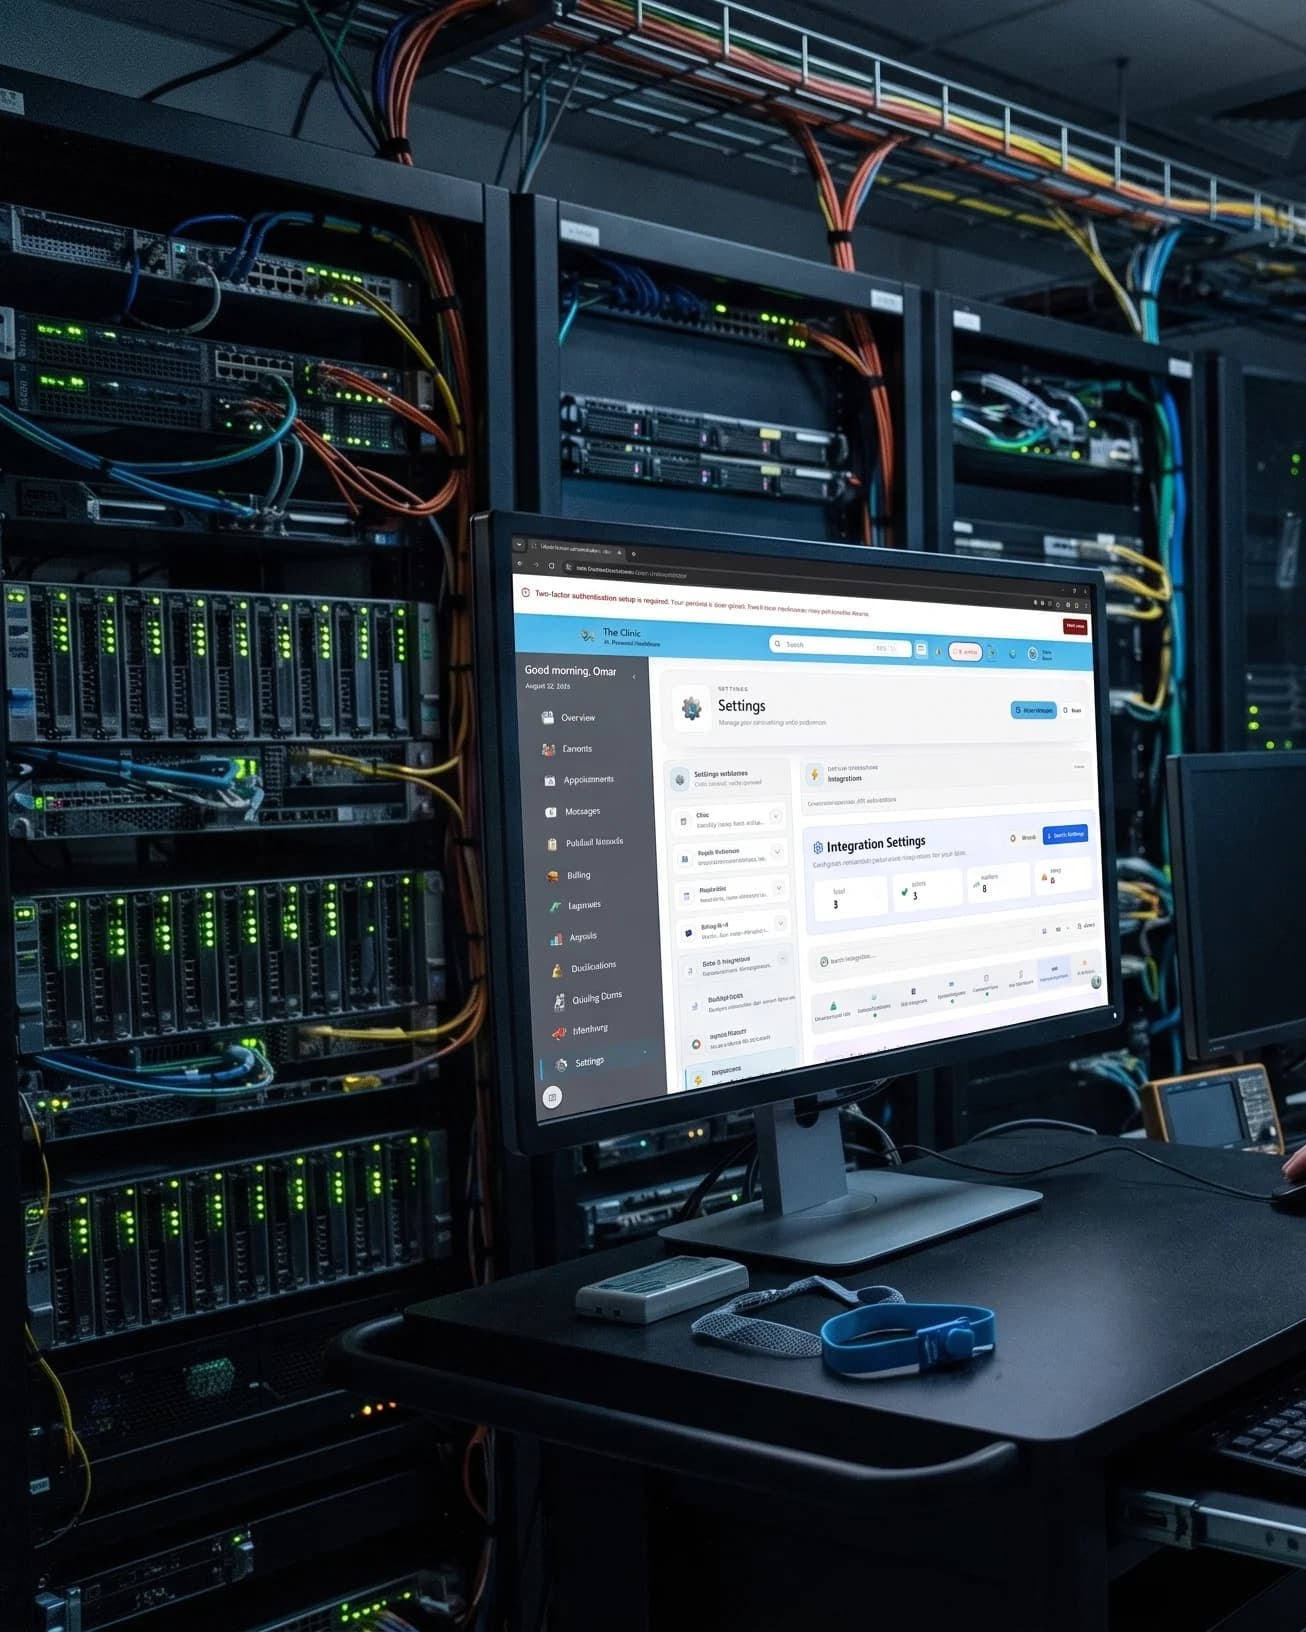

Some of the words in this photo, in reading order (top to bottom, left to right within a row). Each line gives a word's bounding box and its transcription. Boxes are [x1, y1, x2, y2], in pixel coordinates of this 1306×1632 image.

[535, 589, 570, 599] Two-factor
[619, 595, 636, 604] setup
[603, 627, 618, 637] The
[620, 628, 641, 638] Clinic
[525, 664, 550, 675] Good
[551, 666, 592, 678] morning,
[593, 667, 617, 677] Omar
[718, 699, 766, 715] Settings
[561, 713, 596, 722] Overview
[827, 838, 884, 855] Integration
[886, 835, 926, 849] Settings
